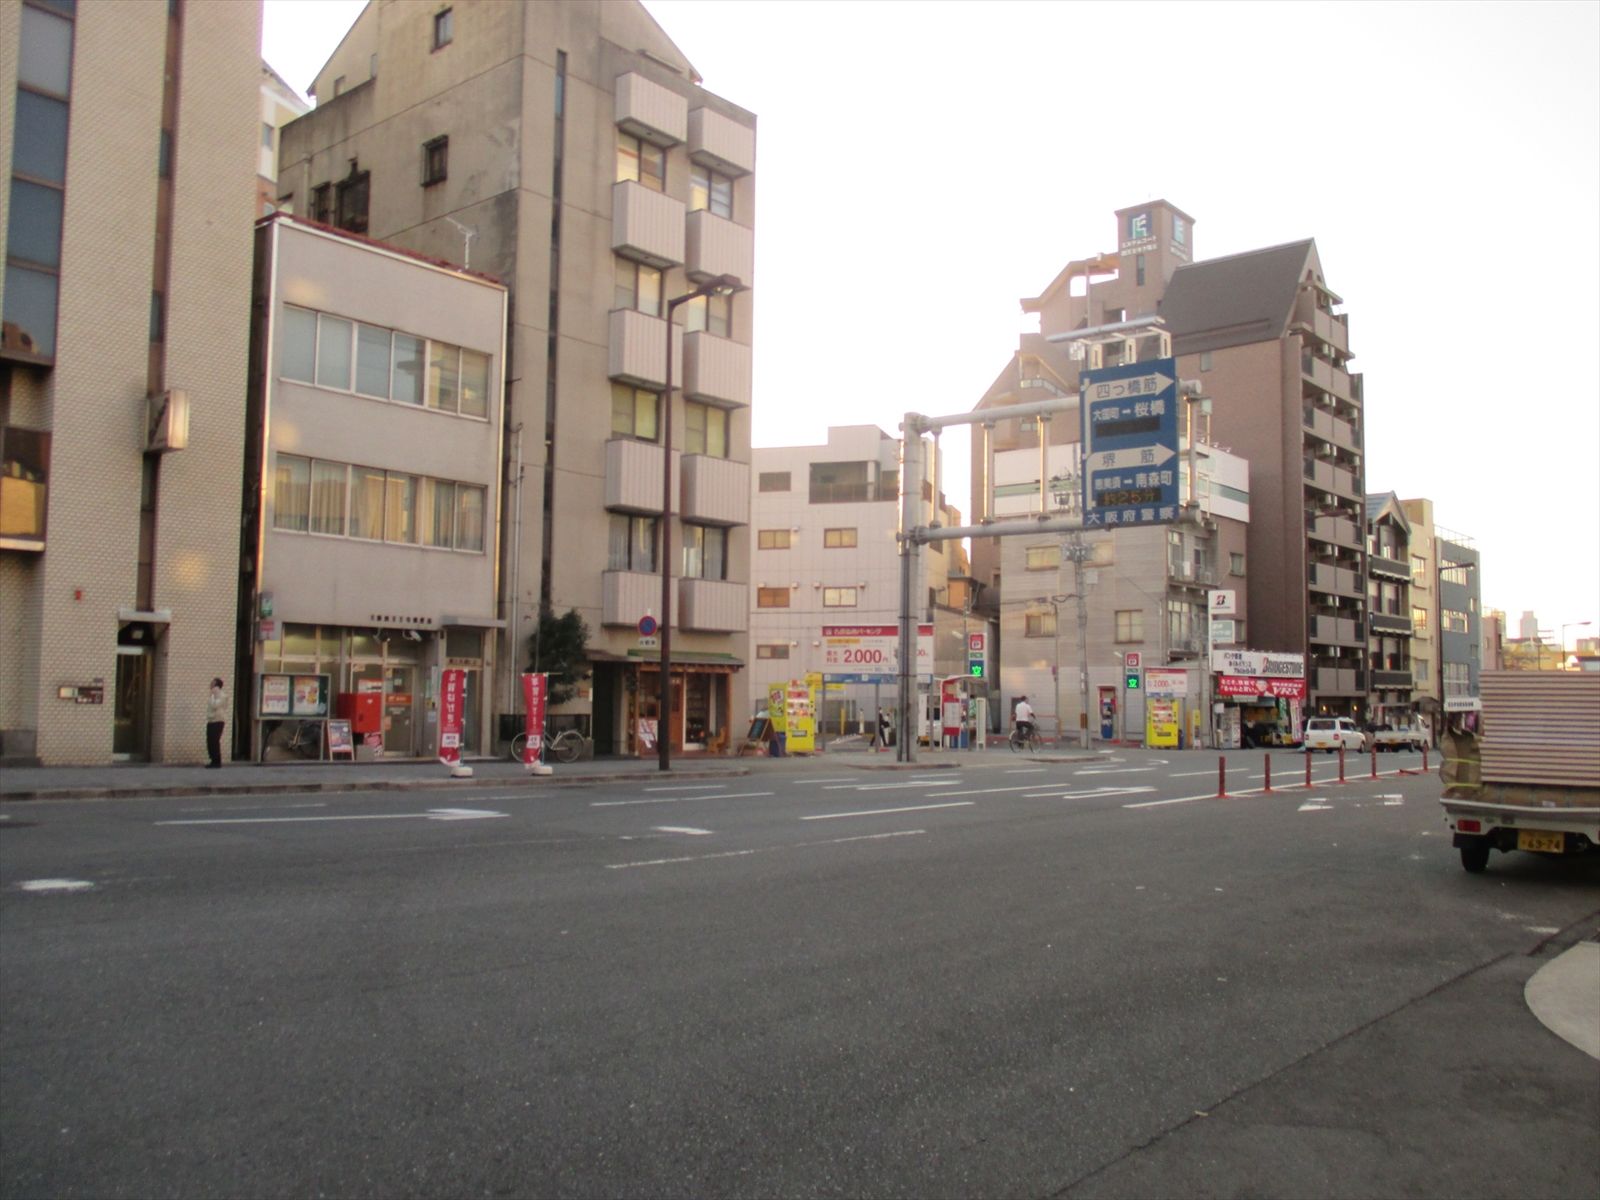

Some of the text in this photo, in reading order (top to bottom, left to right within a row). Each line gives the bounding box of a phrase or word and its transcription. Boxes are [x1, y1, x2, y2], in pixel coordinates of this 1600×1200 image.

[1096, 377, 1157, 399] 四つ橋筋
[1134, 399, 1165, 416] 桜橋
[1088, 508, 1174, 524] 大阪府警察
[1262, 656, 1303, 674] BRIDGESTONE
